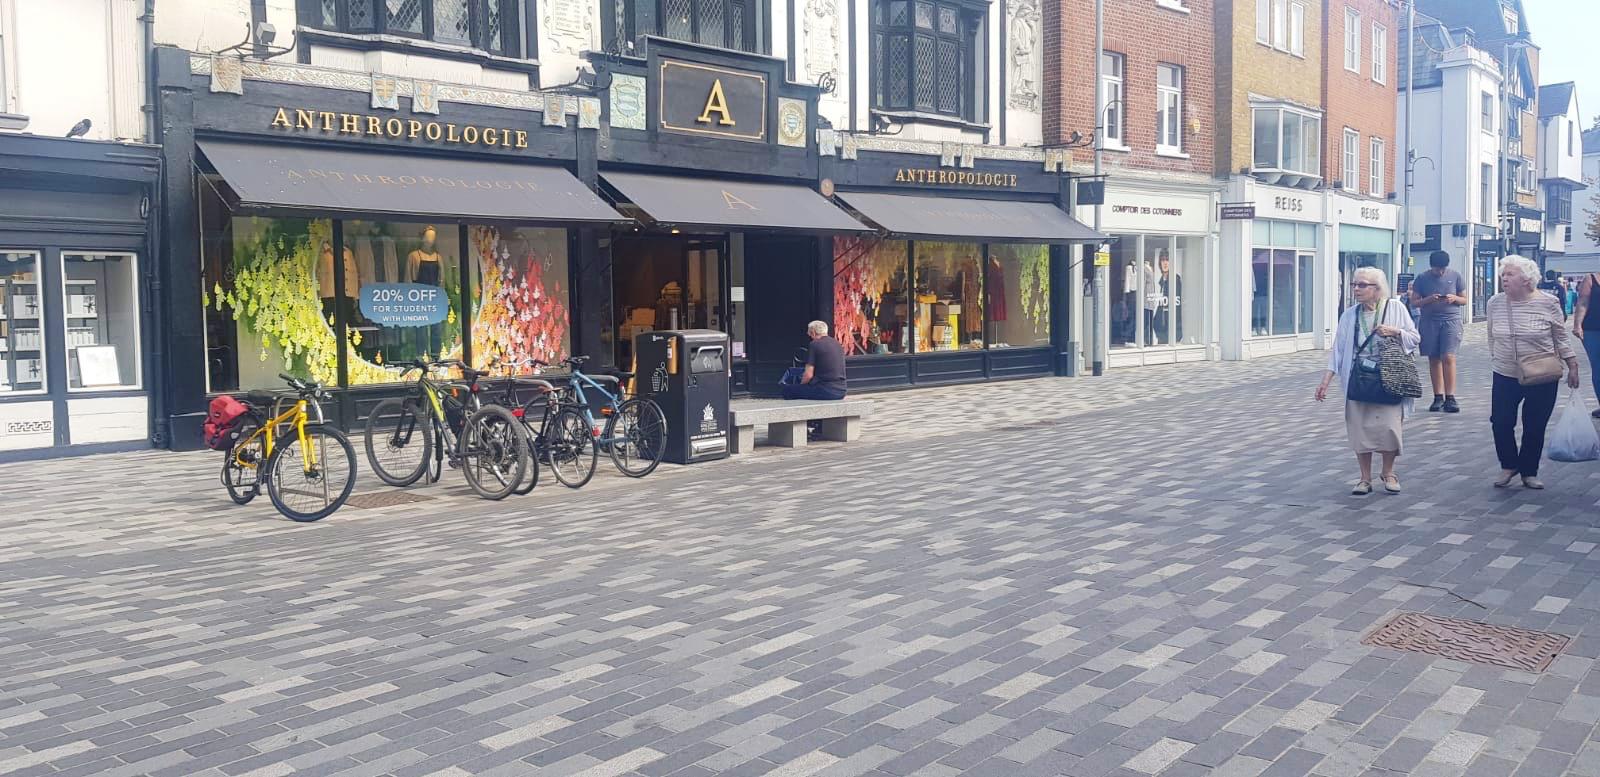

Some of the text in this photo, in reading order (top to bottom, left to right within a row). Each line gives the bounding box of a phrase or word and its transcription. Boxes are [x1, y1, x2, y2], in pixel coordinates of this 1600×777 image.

[697, 79, 736, 126] A
[272, 107, 530, 149] ANTHROPOLOGIE
[286, 168, 543, 192] ANTHROPOLOGIE
[895, 168, 1018, 187] ANTHROPOLOGIE
[720, 188, 757, 211] A
[1274, 196, 1303, 212] REISS
[1112, 205, 1183, 216] COMPTOIR DES COTONNIERS
[1360, 206, 1380, 221] REISS
[372, 289, 437, 302] 20% OFF
